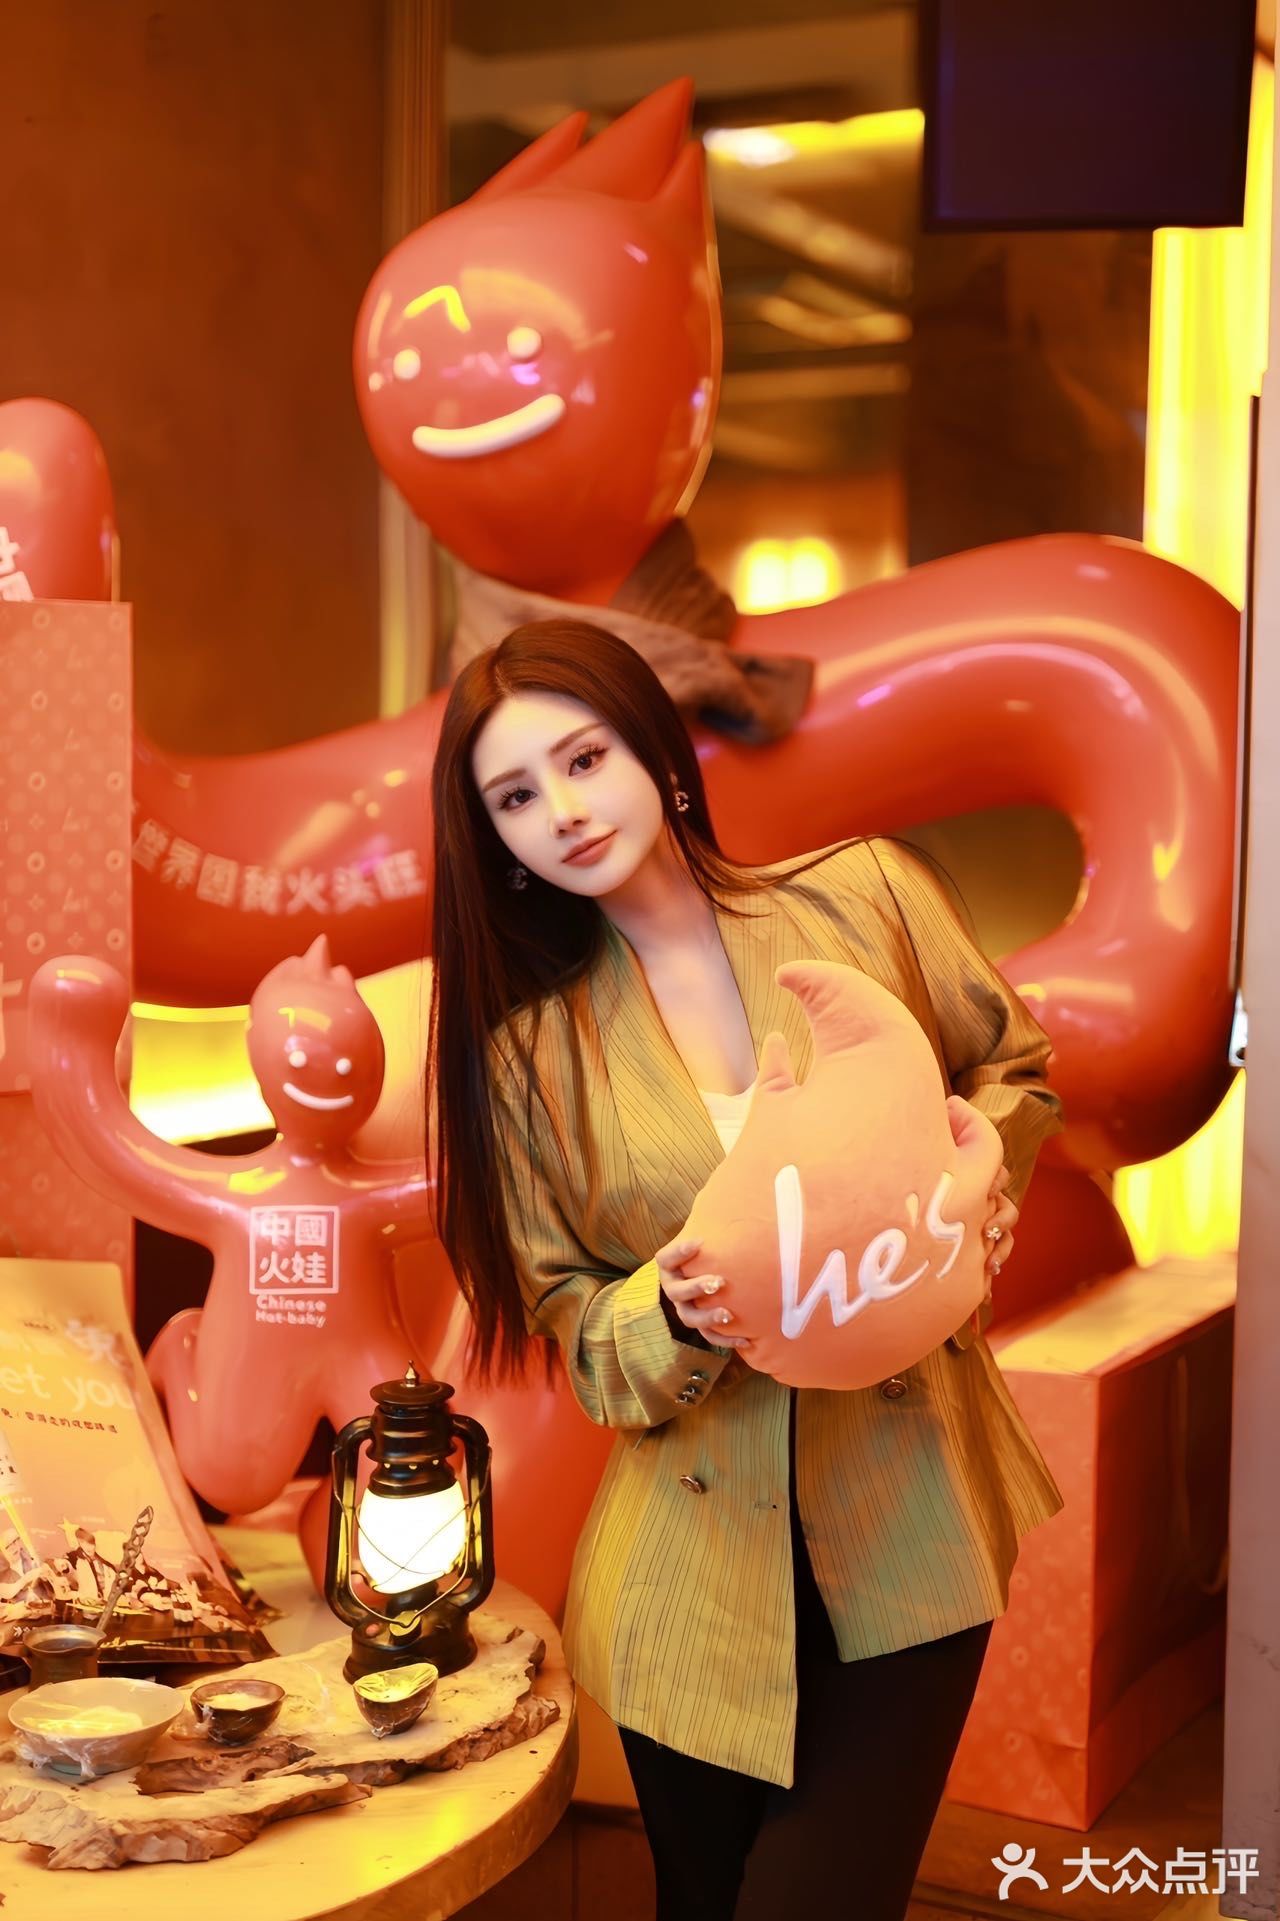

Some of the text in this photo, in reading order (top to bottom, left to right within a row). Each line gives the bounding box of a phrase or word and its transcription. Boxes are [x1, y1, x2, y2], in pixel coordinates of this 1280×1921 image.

[258, 1213, 328, 1248] 中國
[258, 1250, 328, 1285] 火娃
[775, 1164, 966, 1340] he's
[256, 1294, 327, 1313] Chinese
